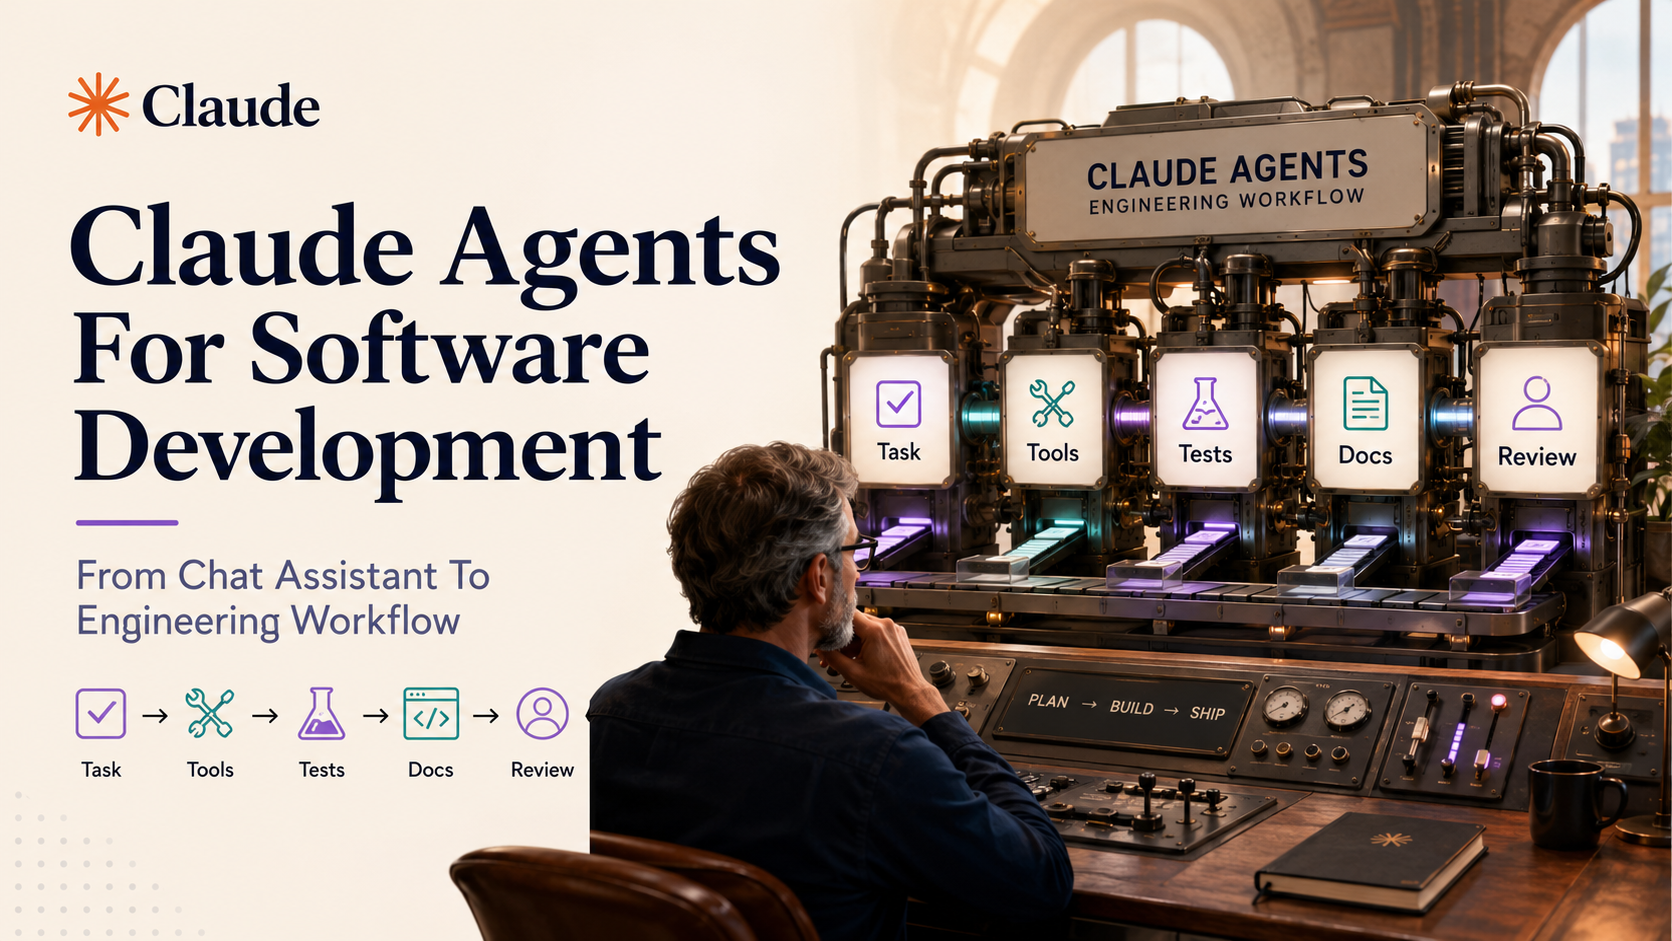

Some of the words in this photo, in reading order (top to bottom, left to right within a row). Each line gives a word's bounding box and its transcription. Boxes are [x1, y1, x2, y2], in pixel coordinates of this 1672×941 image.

[1088, 157, 1216, 190] CLAUDE
[1230, 149, 1367, 183] AGENTS
[1090, 194, 1228, 214] ENGINEERING
[1239, 188, 1364, 208] WORKFLOW
[877, 442, 920, 460] Task
[1027, 443, 1078, 461] Tools
[1179, 444, 1232, 463] Tests
[1340, 445, 1392, 464] Docs
[1499, 446, 1576, 466] Review
[1028, 694, 1069, 708] PLAN
[1110, 700, 1153, 714] BUILD
[1190, 707, 1225, 720] SHIP
